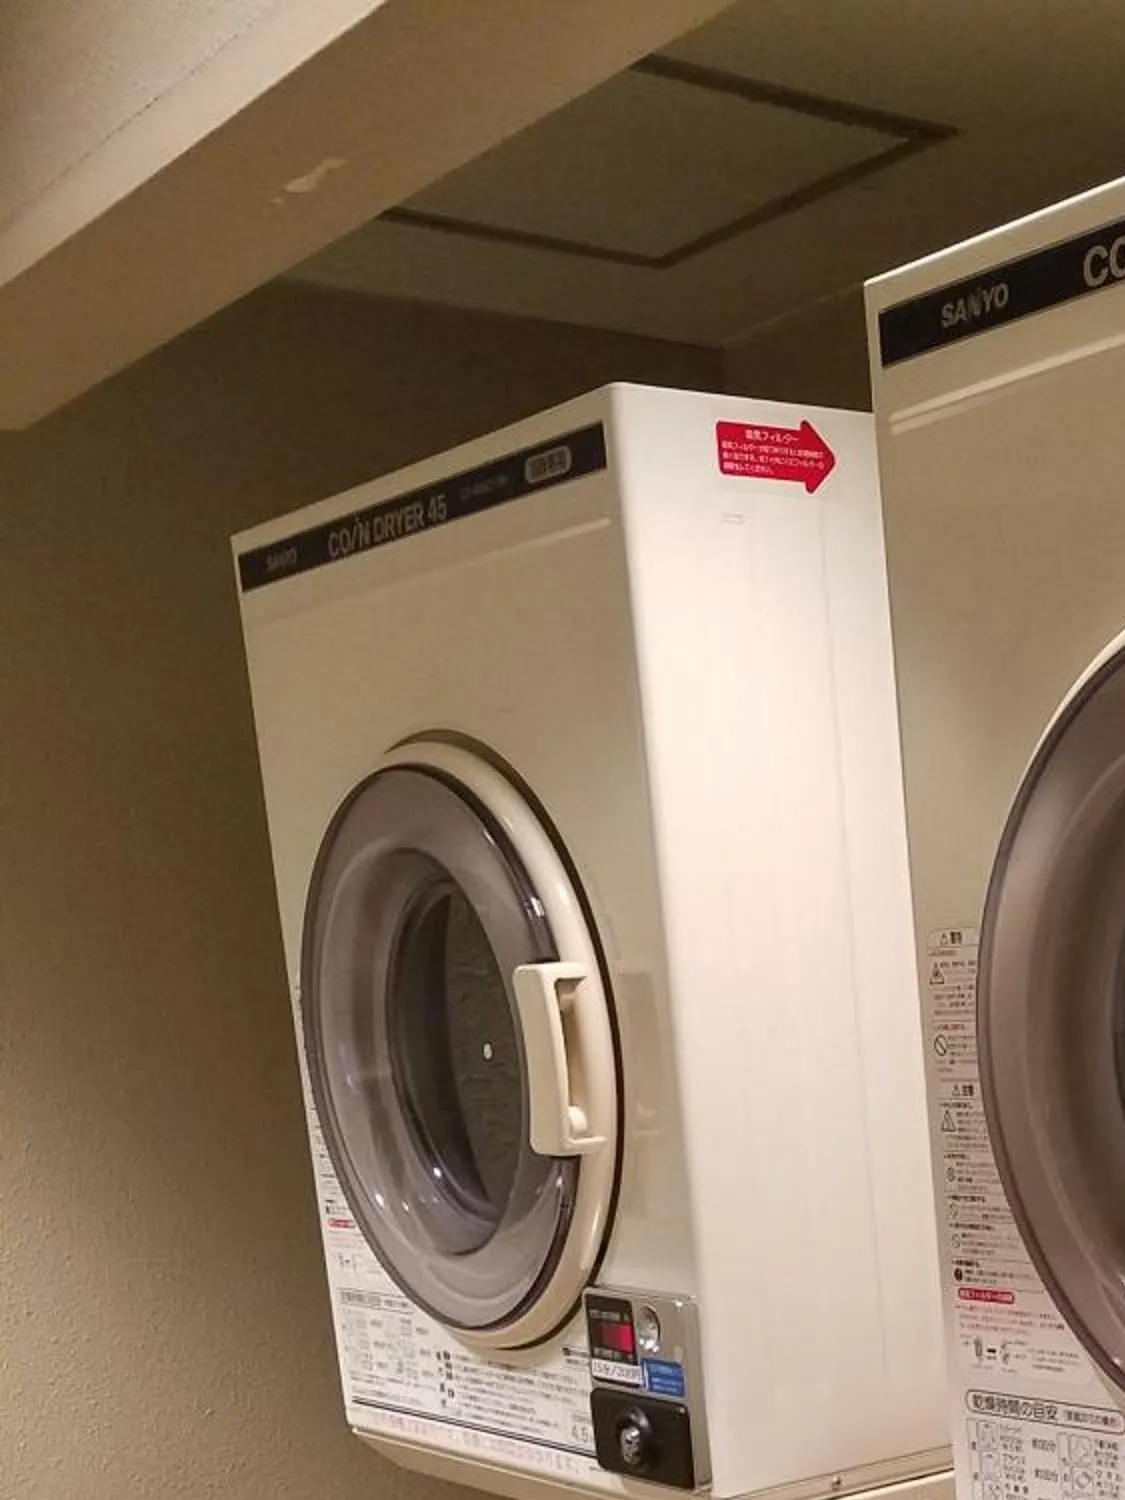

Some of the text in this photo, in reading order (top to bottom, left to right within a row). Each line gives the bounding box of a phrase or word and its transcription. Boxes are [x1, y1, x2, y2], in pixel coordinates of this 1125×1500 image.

[940, 281, 1010, 328] SANYO
[372, 501, 425, 543] DRYER
[426, 494, 448, 523] 45
